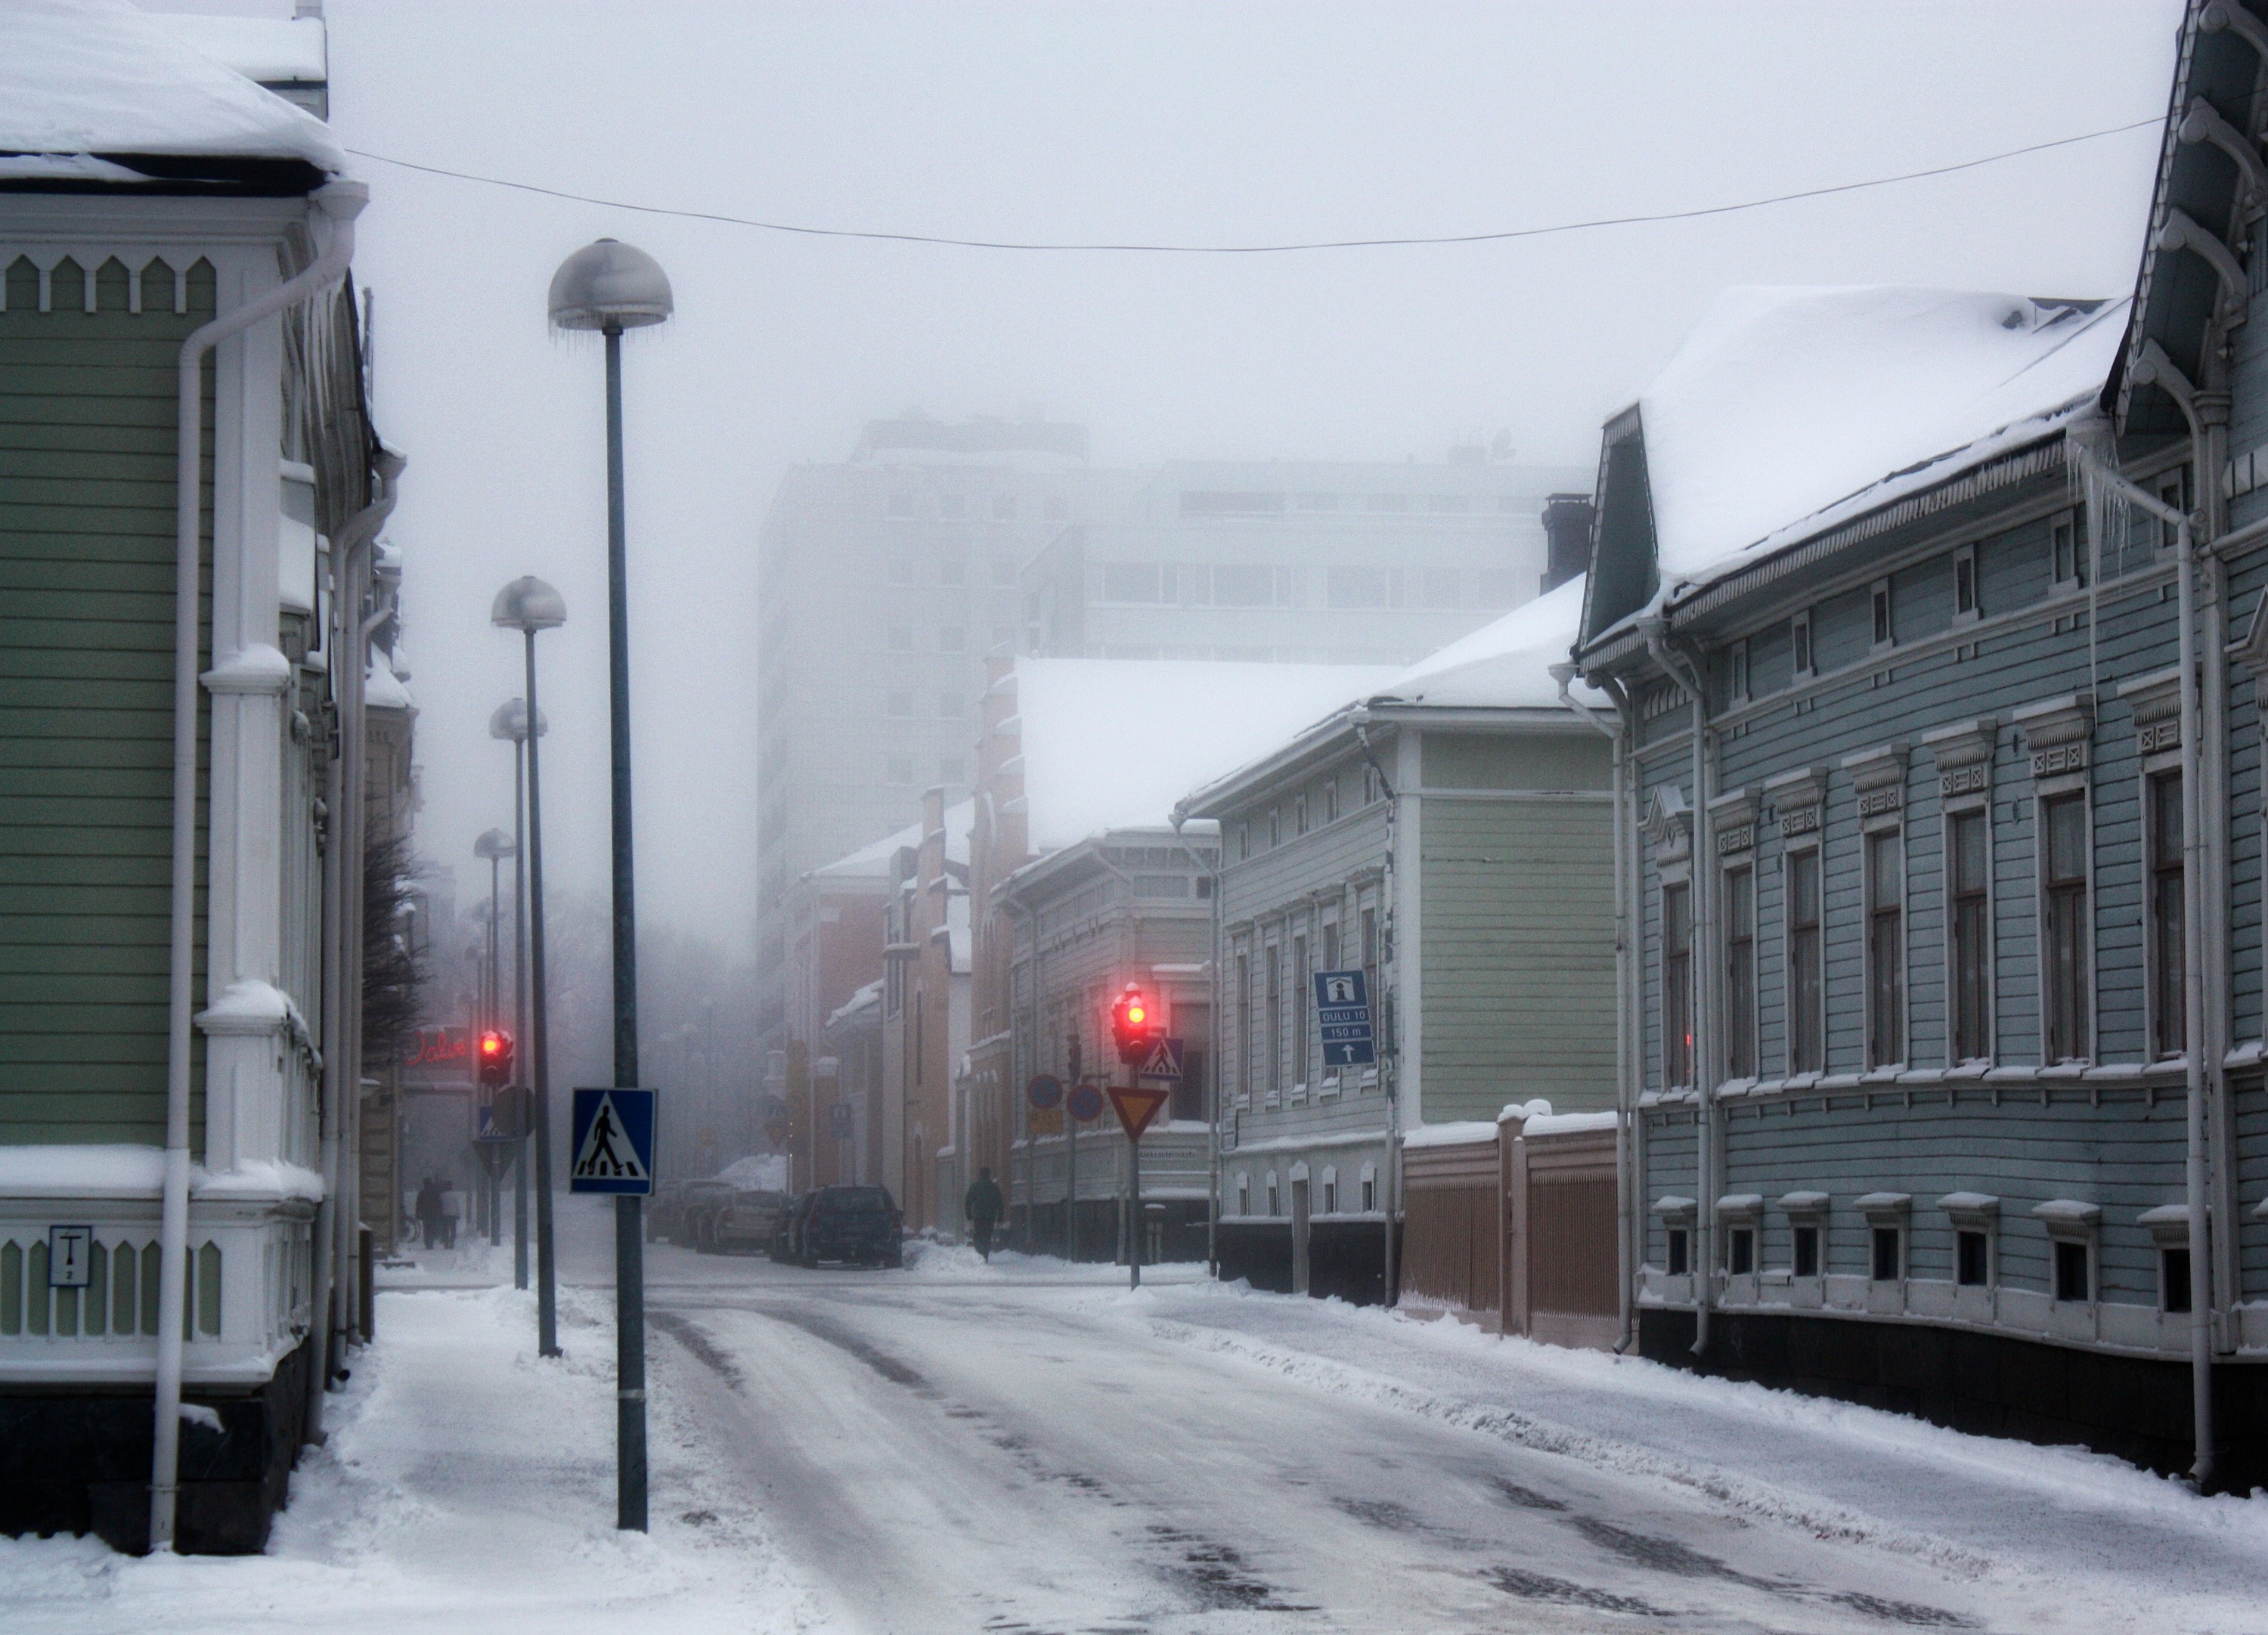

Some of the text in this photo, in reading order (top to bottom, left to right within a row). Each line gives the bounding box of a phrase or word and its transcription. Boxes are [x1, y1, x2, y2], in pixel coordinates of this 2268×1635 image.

[1323, 1011, 1365, 1021] OULU 10
[1331, 1027, 1361, 1038] 150 m
[66, 1271, 73, 1280] 2
